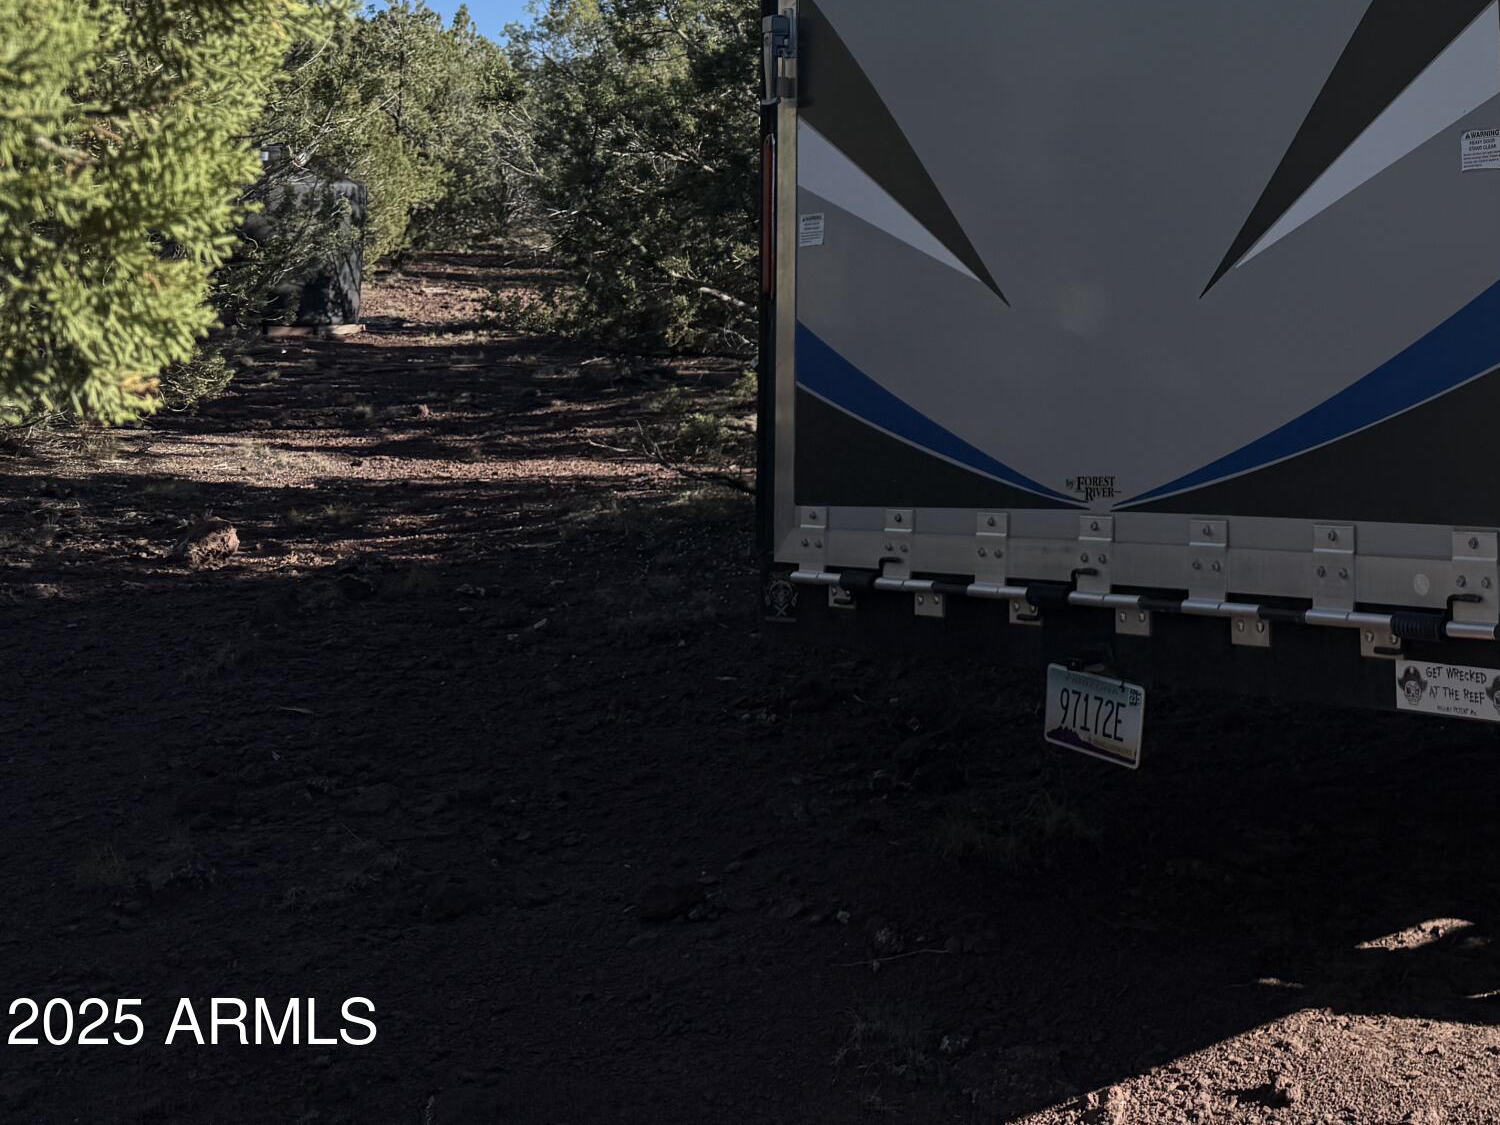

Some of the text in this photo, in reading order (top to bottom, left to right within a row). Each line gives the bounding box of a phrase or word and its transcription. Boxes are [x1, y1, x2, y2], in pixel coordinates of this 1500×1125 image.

[1470, 129, 1499, 138] WARNING
[1077, 476, 1115, 490] FOREST
[1085, 485, 1114, 501] RIVER
[1425, 666, 1487, 684] GET WRECKED
[1429, 685, 1486, 705] AT THE REEF
[1060, 687, 1126, 742] 97172E
